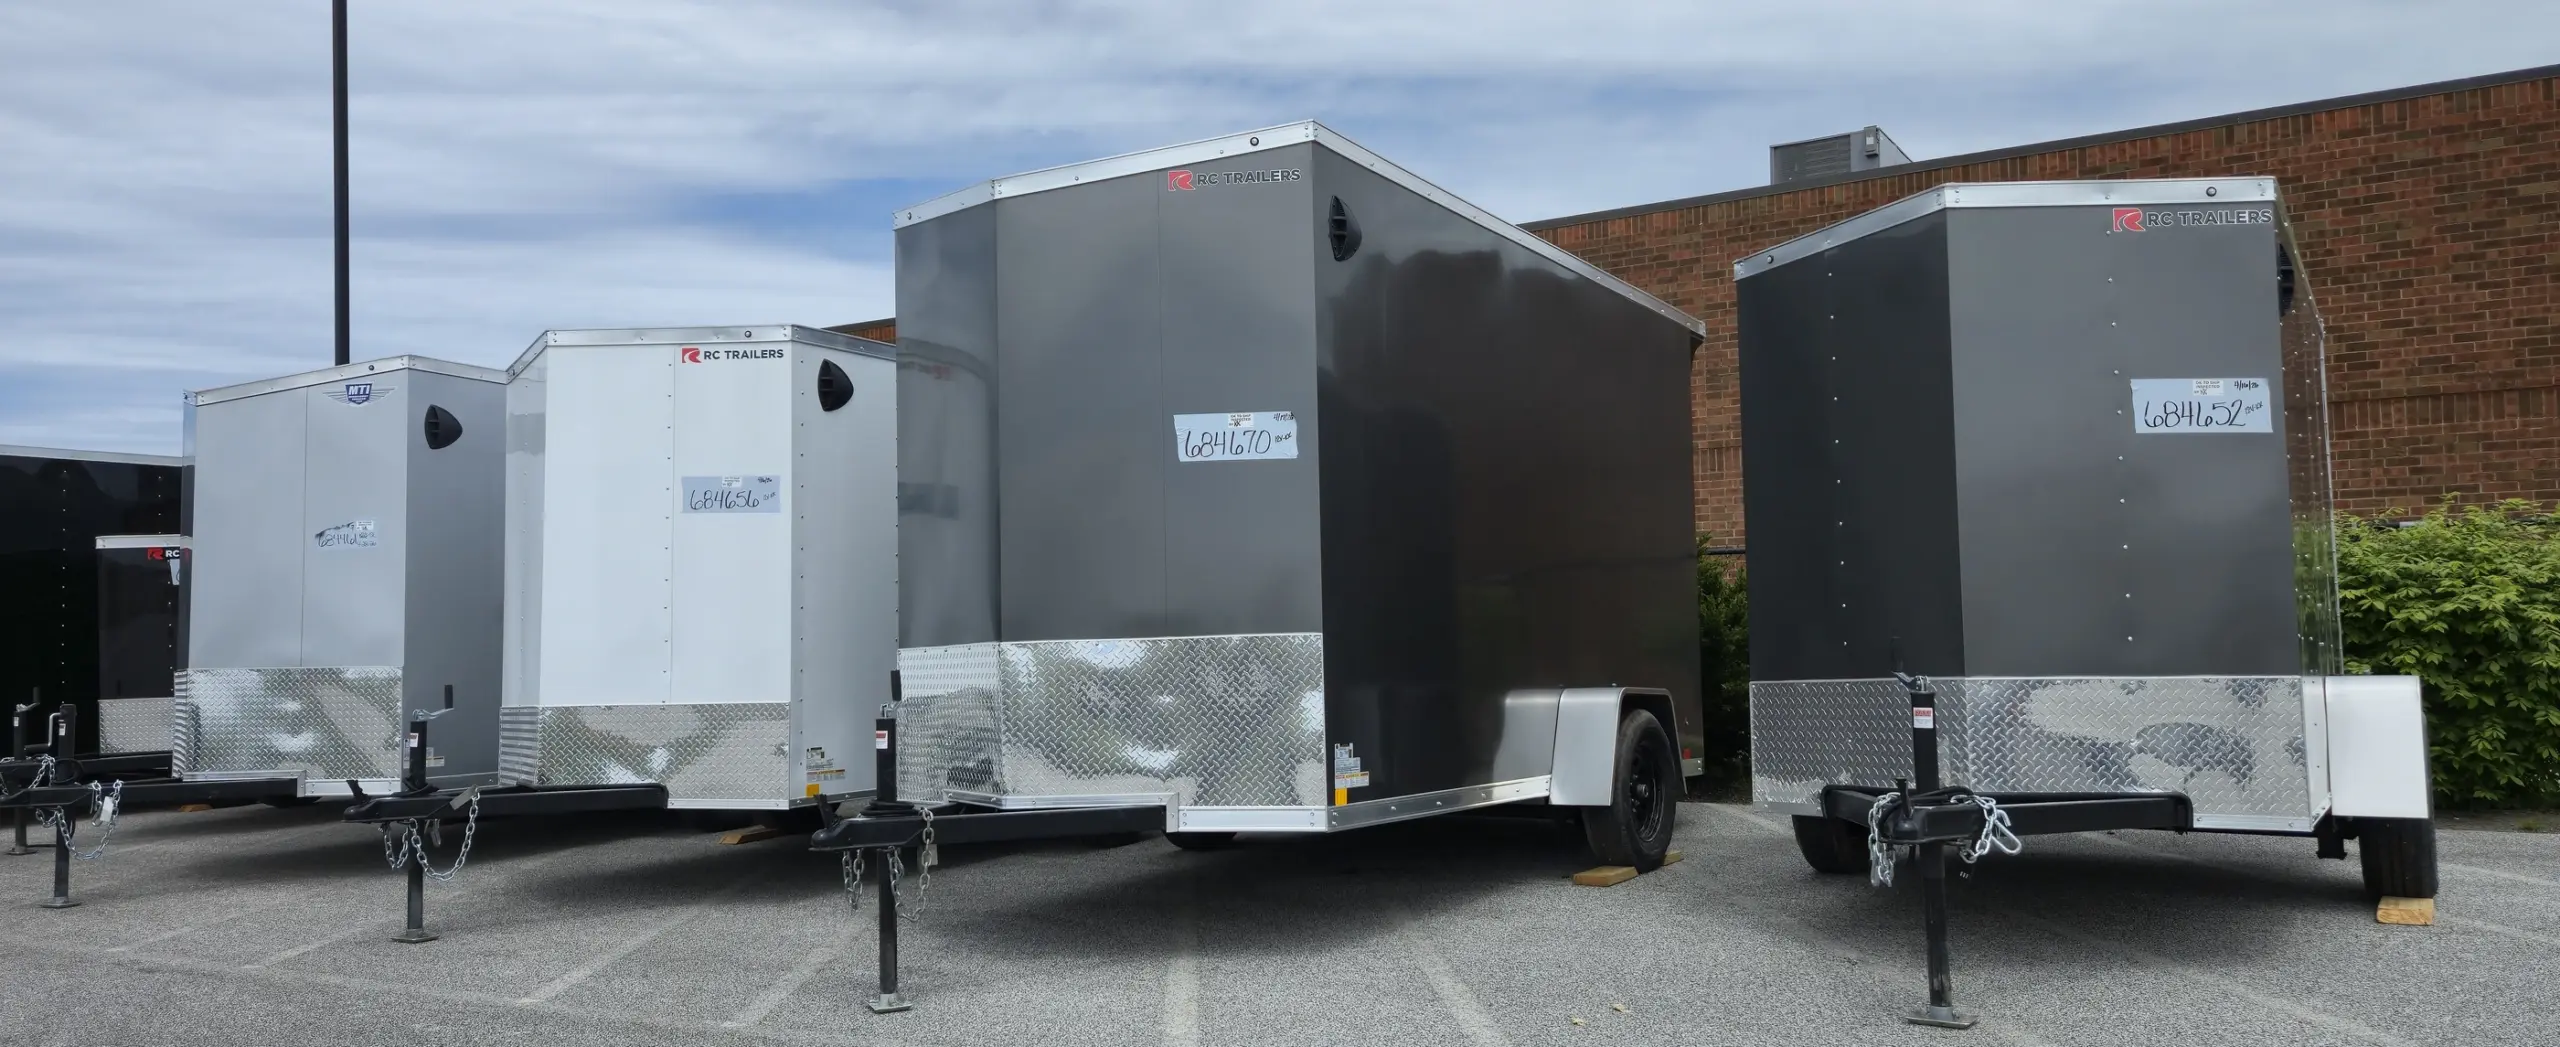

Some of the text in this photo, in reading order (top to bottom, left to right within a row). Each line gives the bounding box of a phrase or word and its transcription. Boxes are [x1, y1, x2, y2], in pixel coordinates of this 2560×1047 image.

[1197, 169, 1301, 185] RC TRAILERS
[2147, 209, 2272, 227] RC TRAILERS
[703, 349, 784, 360] RC TRAILERS
[348, 385, 371, 395] MTI
[2144, 399, 2246, 428] 684652
[1185, 429, 1271, 458] 684670
[690, 489, 760, 511] 684656
[165, 550, 180, 558] RC
